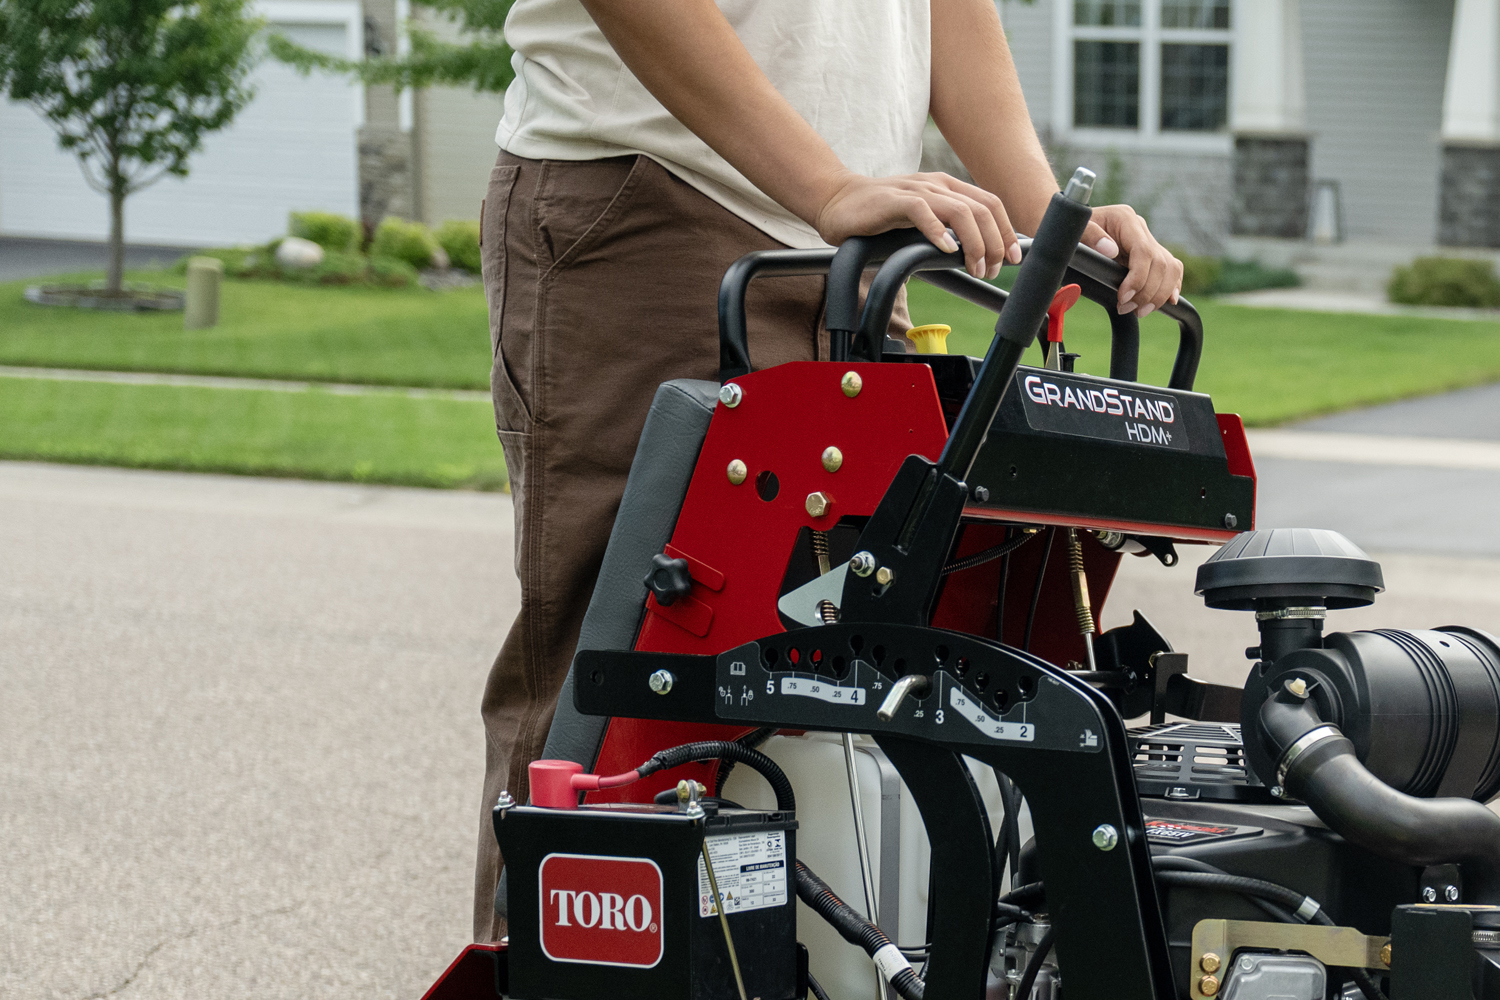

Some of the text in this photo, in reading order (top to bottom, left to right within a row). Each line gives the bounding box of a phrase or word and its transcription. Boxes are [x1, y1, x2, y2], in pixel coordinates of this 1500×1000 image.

[1125, 421, 1173, 446] HDM+
[766, 680, 775, 694] 5
[787, 682, 797, 690] .75
[831, 690, 842, 698] .25
[850, 690, 859, 703] 4
[871, 682, 883, 690] .75
[913, 710, 924, 718] .25
[935, 710, 945, 724] 3
[955, 698, 966, 706] .75
[974, 715, 985, 723] .50
[993, 726, 1004, 734] .25
[1020, 725, 1028, 738] 2
[550, 889, 653, 933] TORO
